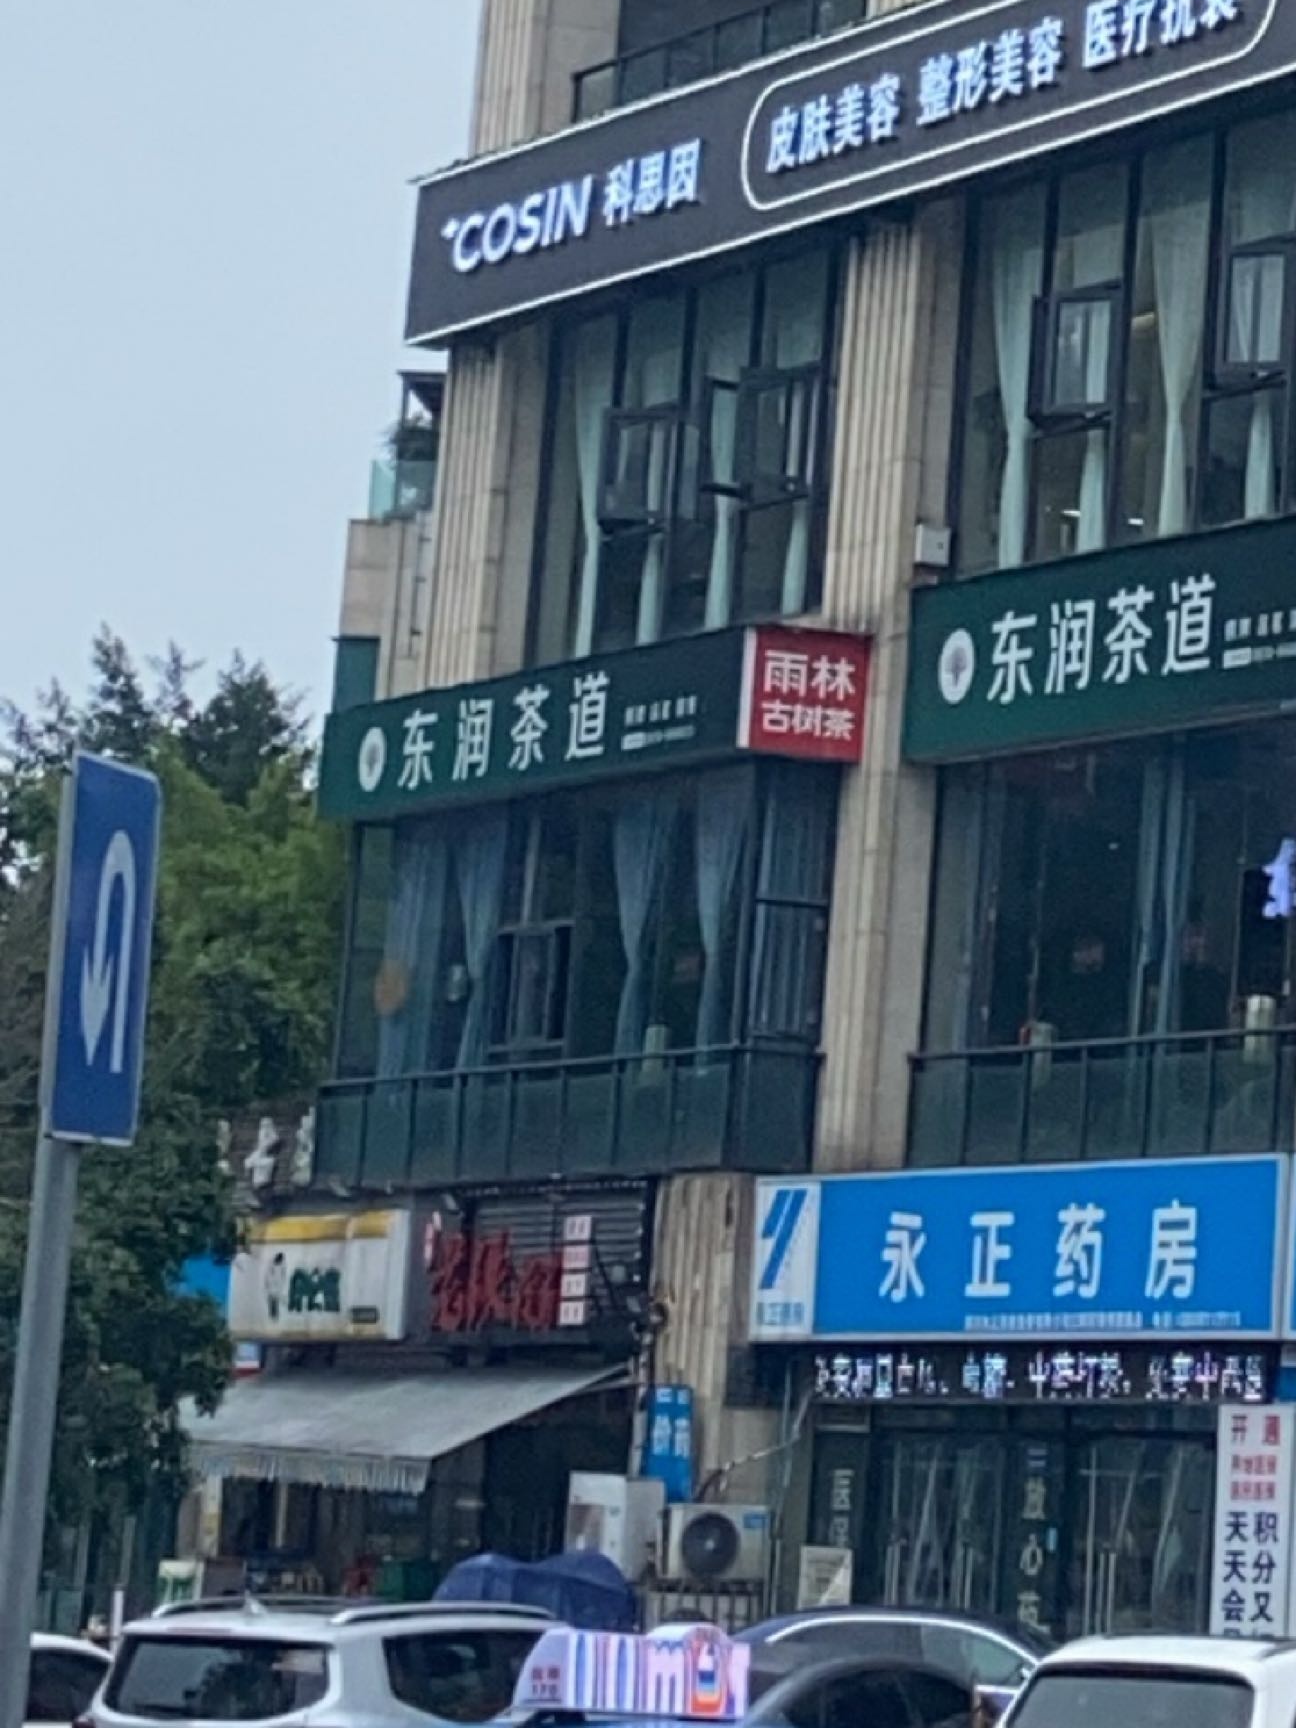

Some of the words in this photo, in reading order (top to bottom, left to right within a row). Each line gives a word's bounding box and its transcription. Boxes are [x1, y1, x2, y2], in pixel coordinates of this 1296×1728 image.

[766, 74, 901, 174] 皮肤美容
[917, 17, 1066, 128] 整形美容
[450, 175, 594, 275] COSIN
[602, 137, 702, 227] 科思因
[763, 650, 857, 700] 雨林
[988, 573, 1217, 706] 东润茶道
[397, 671, 612, 791] 东润茶道
[760, 699, 855, 741] 古树茶
[879, 1199, 1199, 1302] 永正药房
